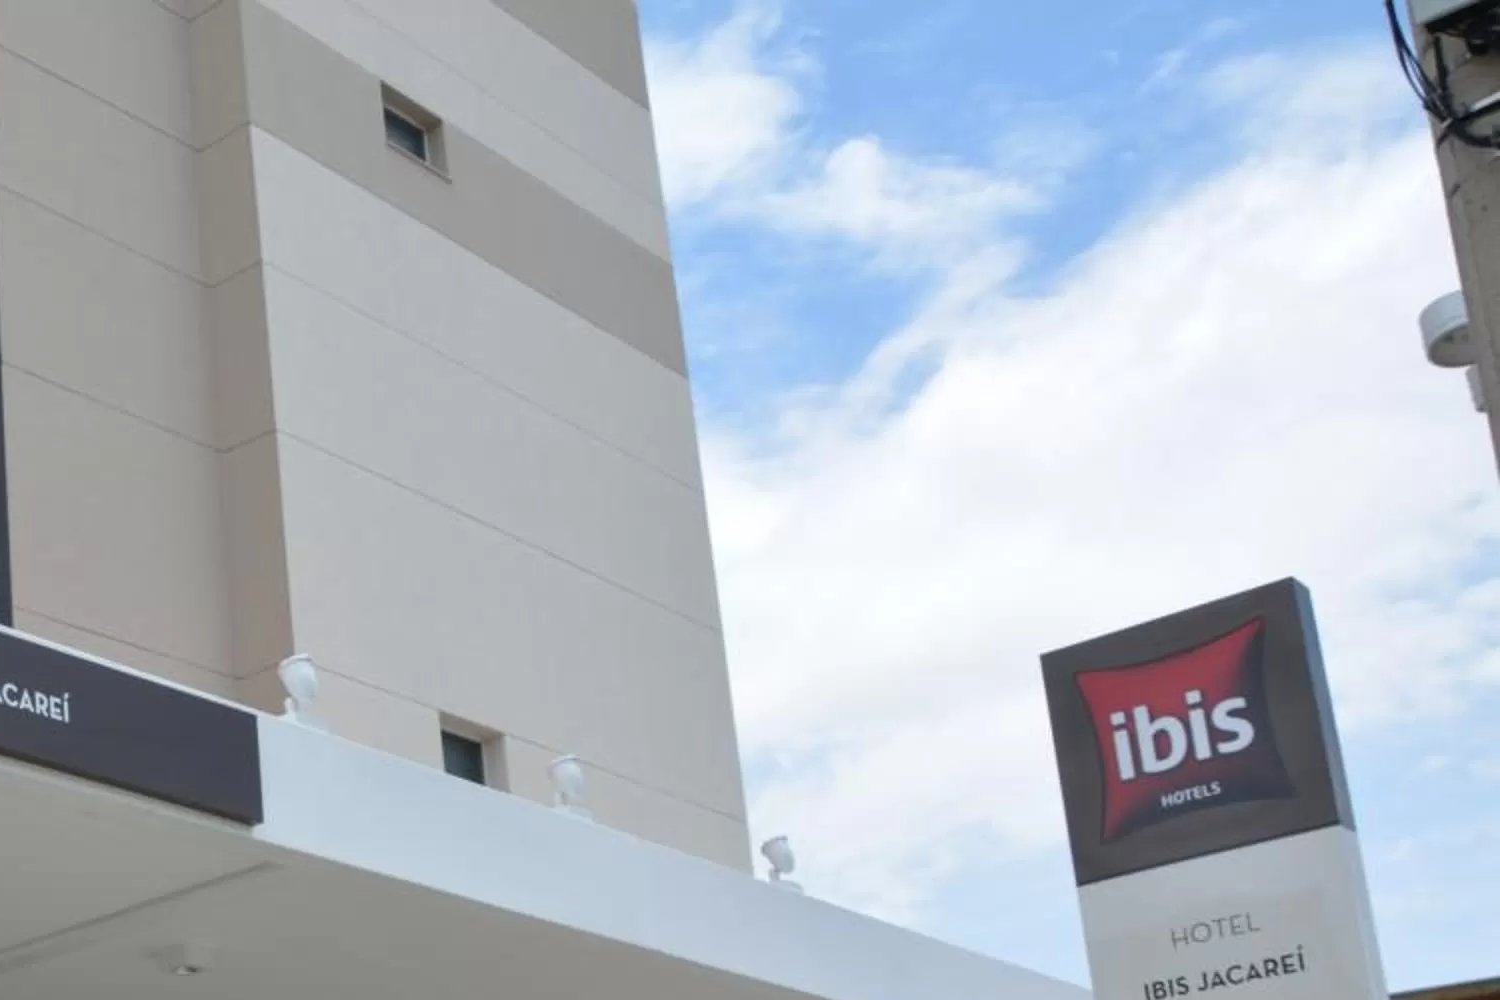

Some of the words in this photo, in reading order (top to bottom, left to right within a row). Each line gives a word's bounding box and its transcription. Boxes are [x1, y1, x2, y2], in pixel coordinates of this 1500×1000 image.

[1109, 689, 1256, 781] ibis
[1160, 779, 1222, 808] HOTELS
[1169, 911, 1262, 952] HOTEL
[1197, 943, 1307, 993] JACAREÍ
